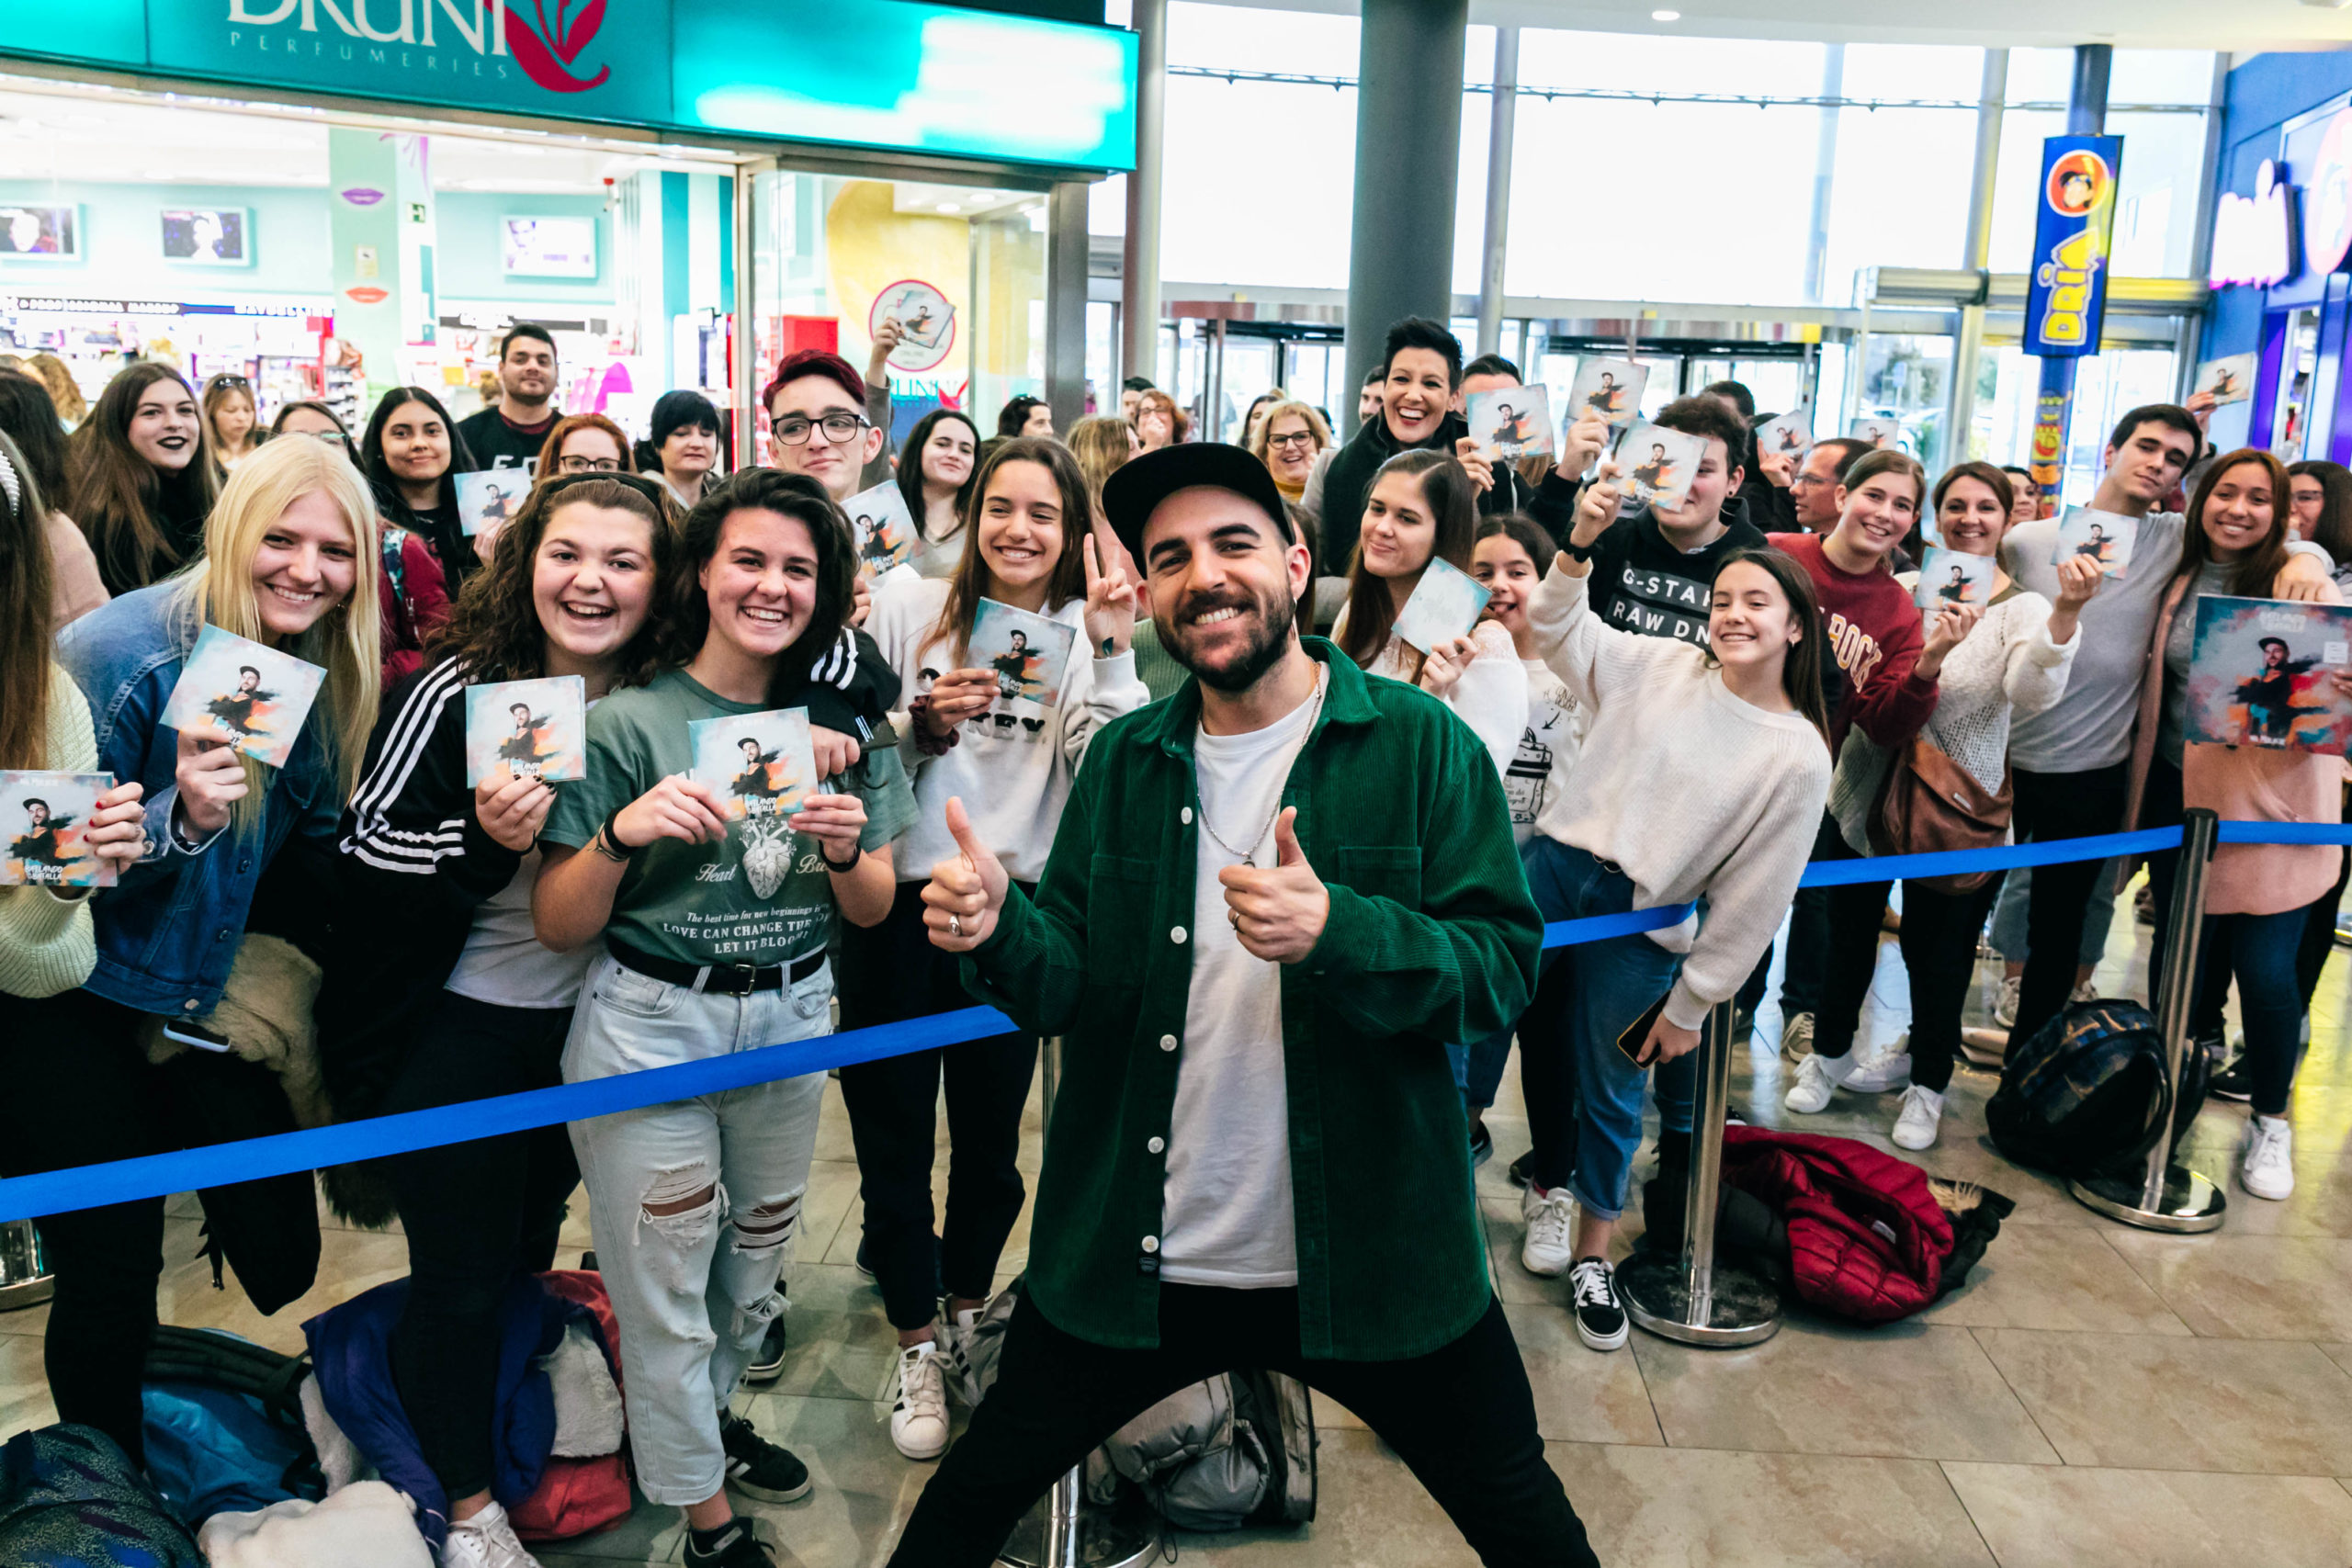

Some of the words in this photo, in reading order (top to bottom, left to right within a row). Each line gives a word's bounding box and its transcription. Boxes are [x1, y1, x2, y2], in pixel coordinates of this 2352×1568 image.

[231, 31, 507, 79] PERFUMERIES
[890, 378, 939, 401] UNI
[1612, 600, 1665, 632] RAW
[695, 863, 739, 883] Heart
[687, 912, 703, 922] The
[705, 913, 722, 923] best
[724, 912, 739, 921] time
[741, 910, 752, 920] for
[754, 910, 769, 919] new
[771, 906, 813, 917] beginnings
[663, 923, 698, 938] LOVE
[703, 928, 729, 939] CAN
[733, 920, 783, 937] CHANGE
[786, 919, 812, 931] THE
[714, 942, 740, 954] LET
[745, 940, 758, 952] IT
